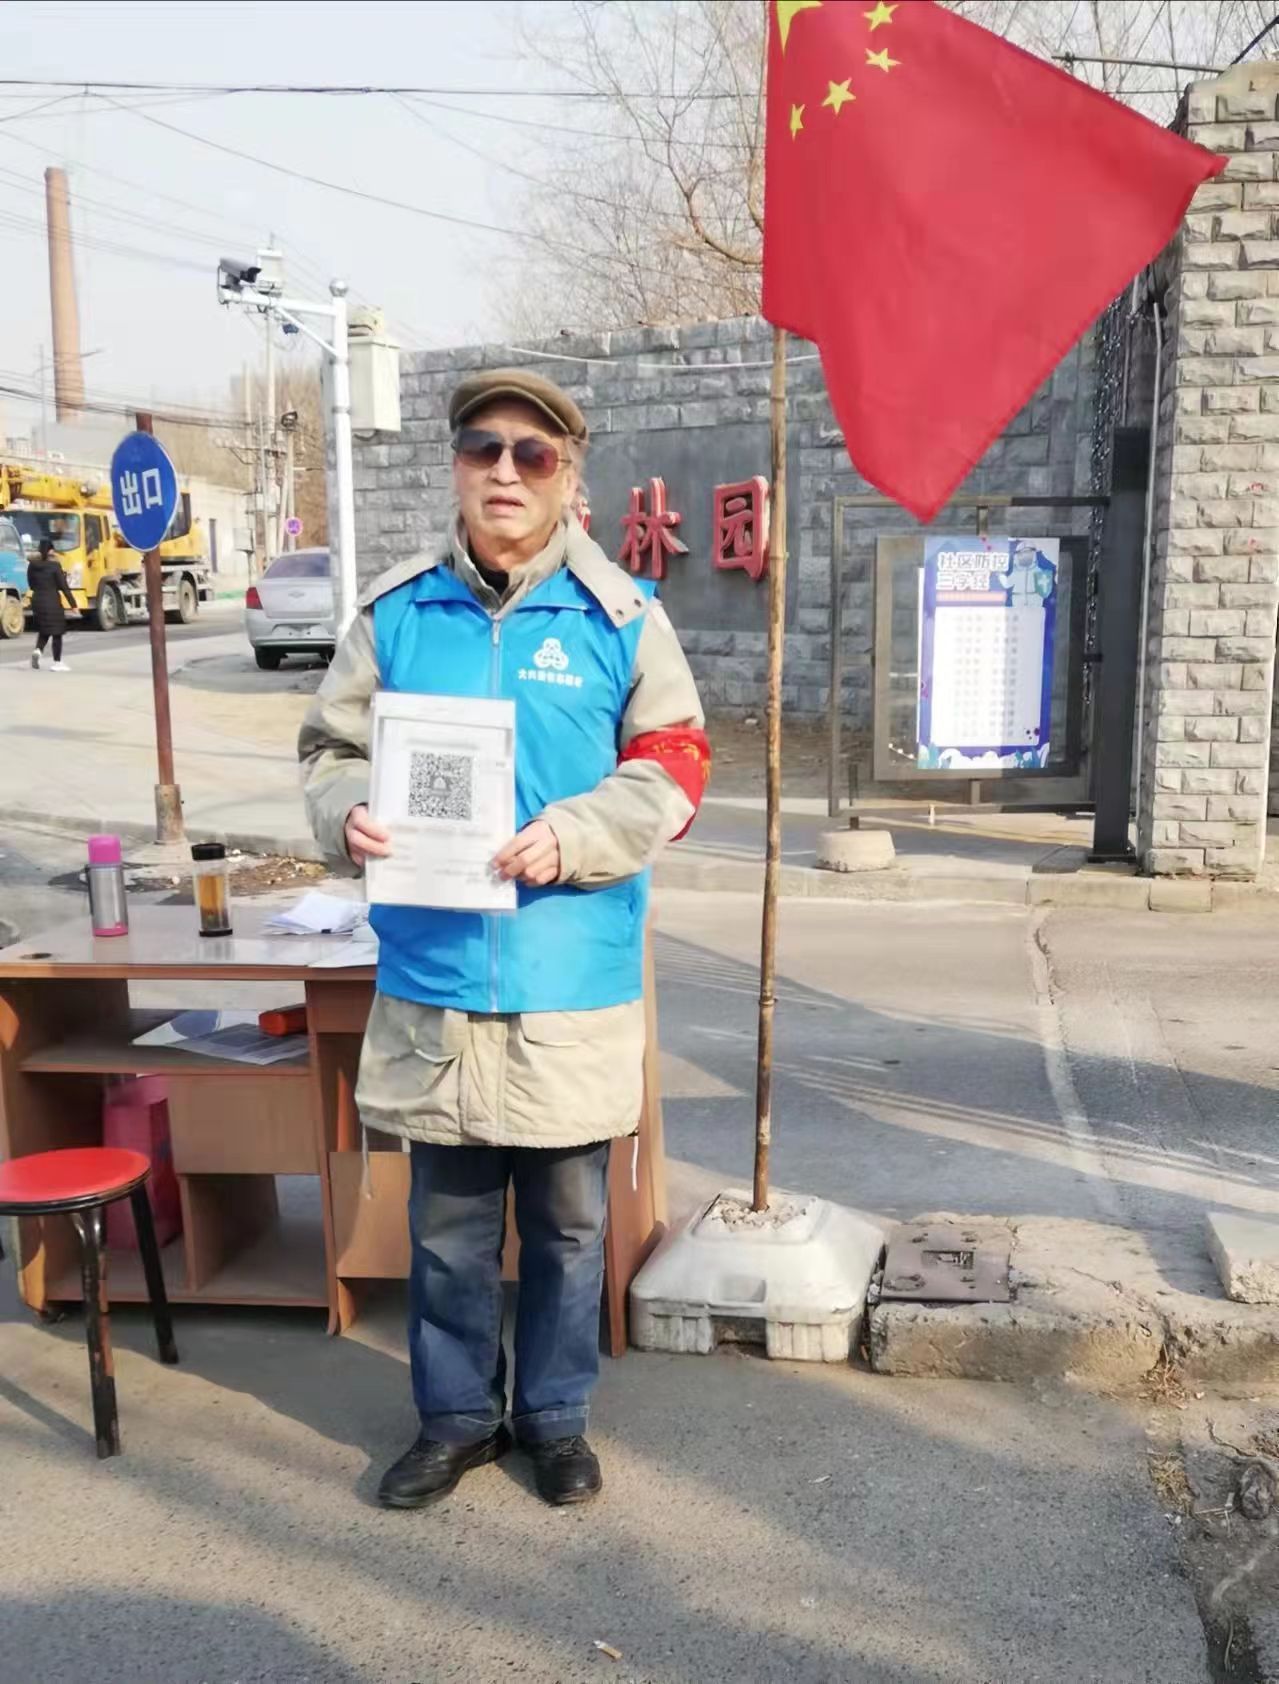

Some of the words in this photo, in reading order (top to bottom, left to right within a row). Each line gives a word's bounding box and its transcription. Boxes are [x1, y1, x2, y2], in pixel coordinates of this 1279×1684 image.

[119, 468, 163, 516] 出口
[577, 476, 770, 580] 林园
[938, 552, 1009, 570] 社区防控
